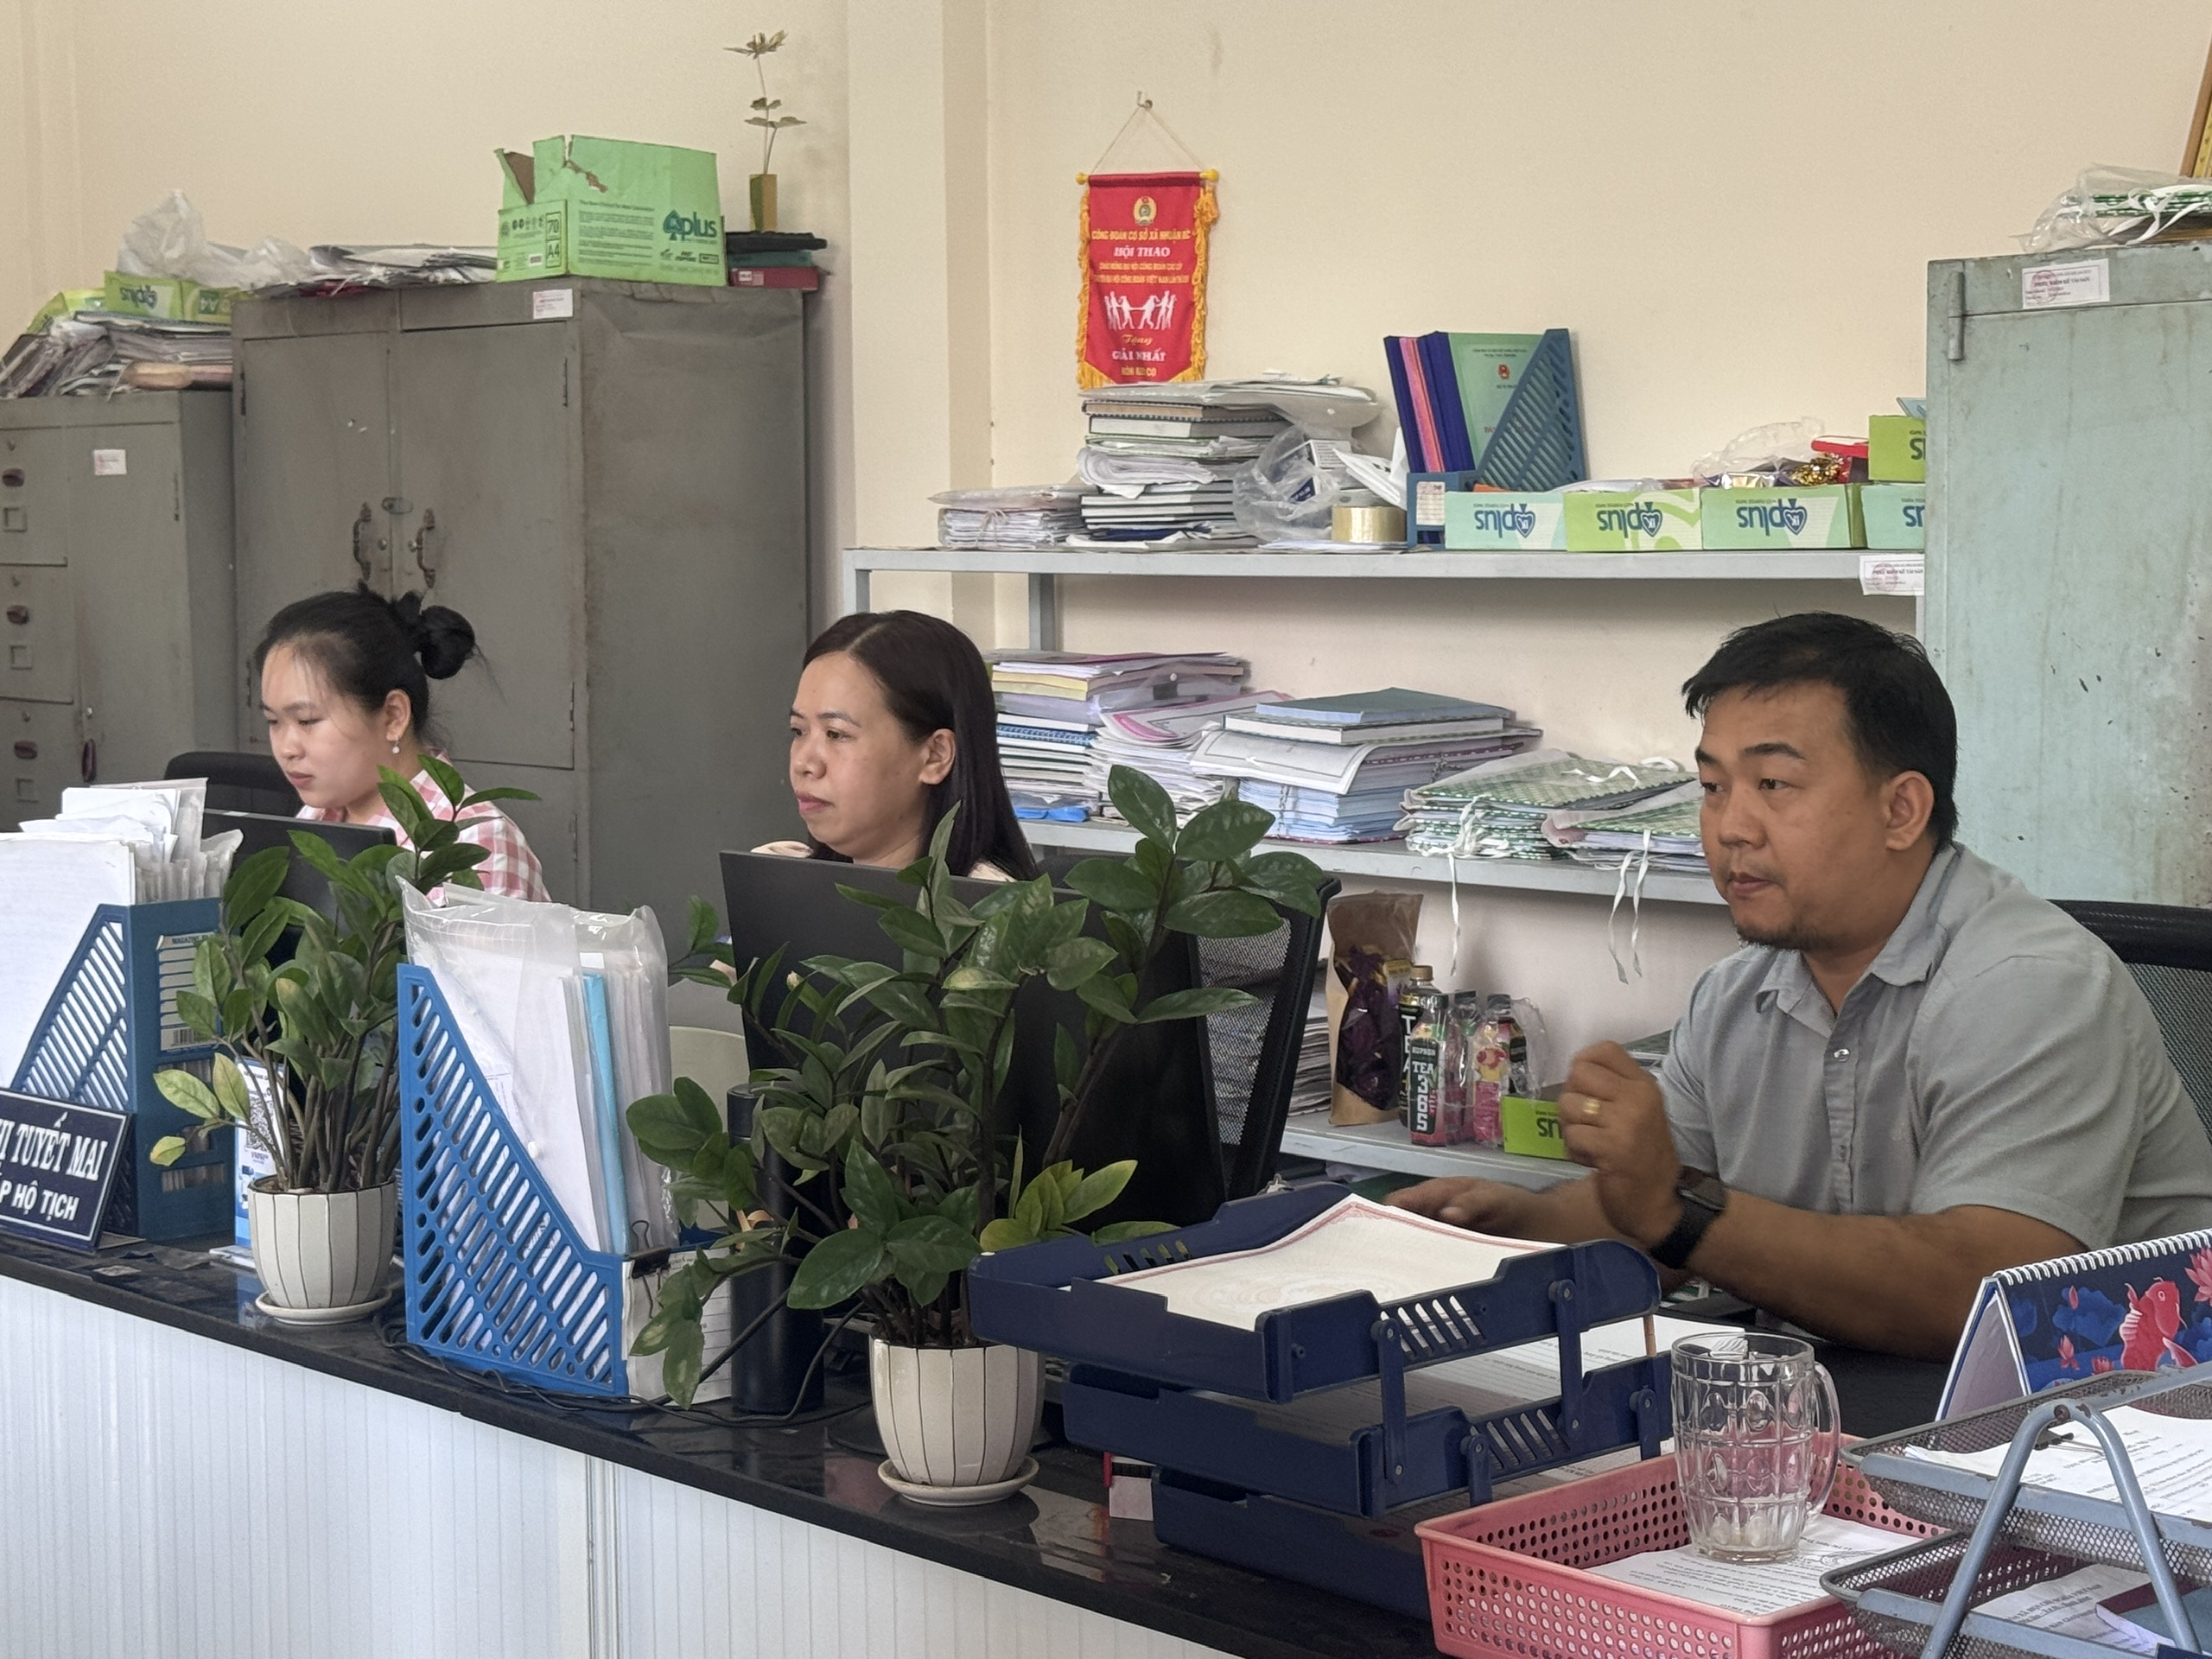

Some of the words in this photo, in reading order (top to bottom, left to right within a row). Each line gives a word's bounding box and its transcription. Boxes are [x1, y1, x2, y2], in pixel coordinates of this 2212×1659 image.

[548, 219, 560, 233] 70
[548, 243, 561, 258] A4
[1137, 246, 1171, 257] THAO
[1475, 503, 1517, 538] plus
[1597, 502, 1643, 538] plus
[1736, 499, 1787, 536] plus
[1412, 1060, 1433, 1074] TEA
[1416, 1074, 1428, 1131] 365
[10, 1111, 72, 1173] TUYẾT
[66, 1135, 108, 1181] MAI
[10, 1179, 38, 1215] HỘ
[40, 1189, 80, 1222] TỊCH
